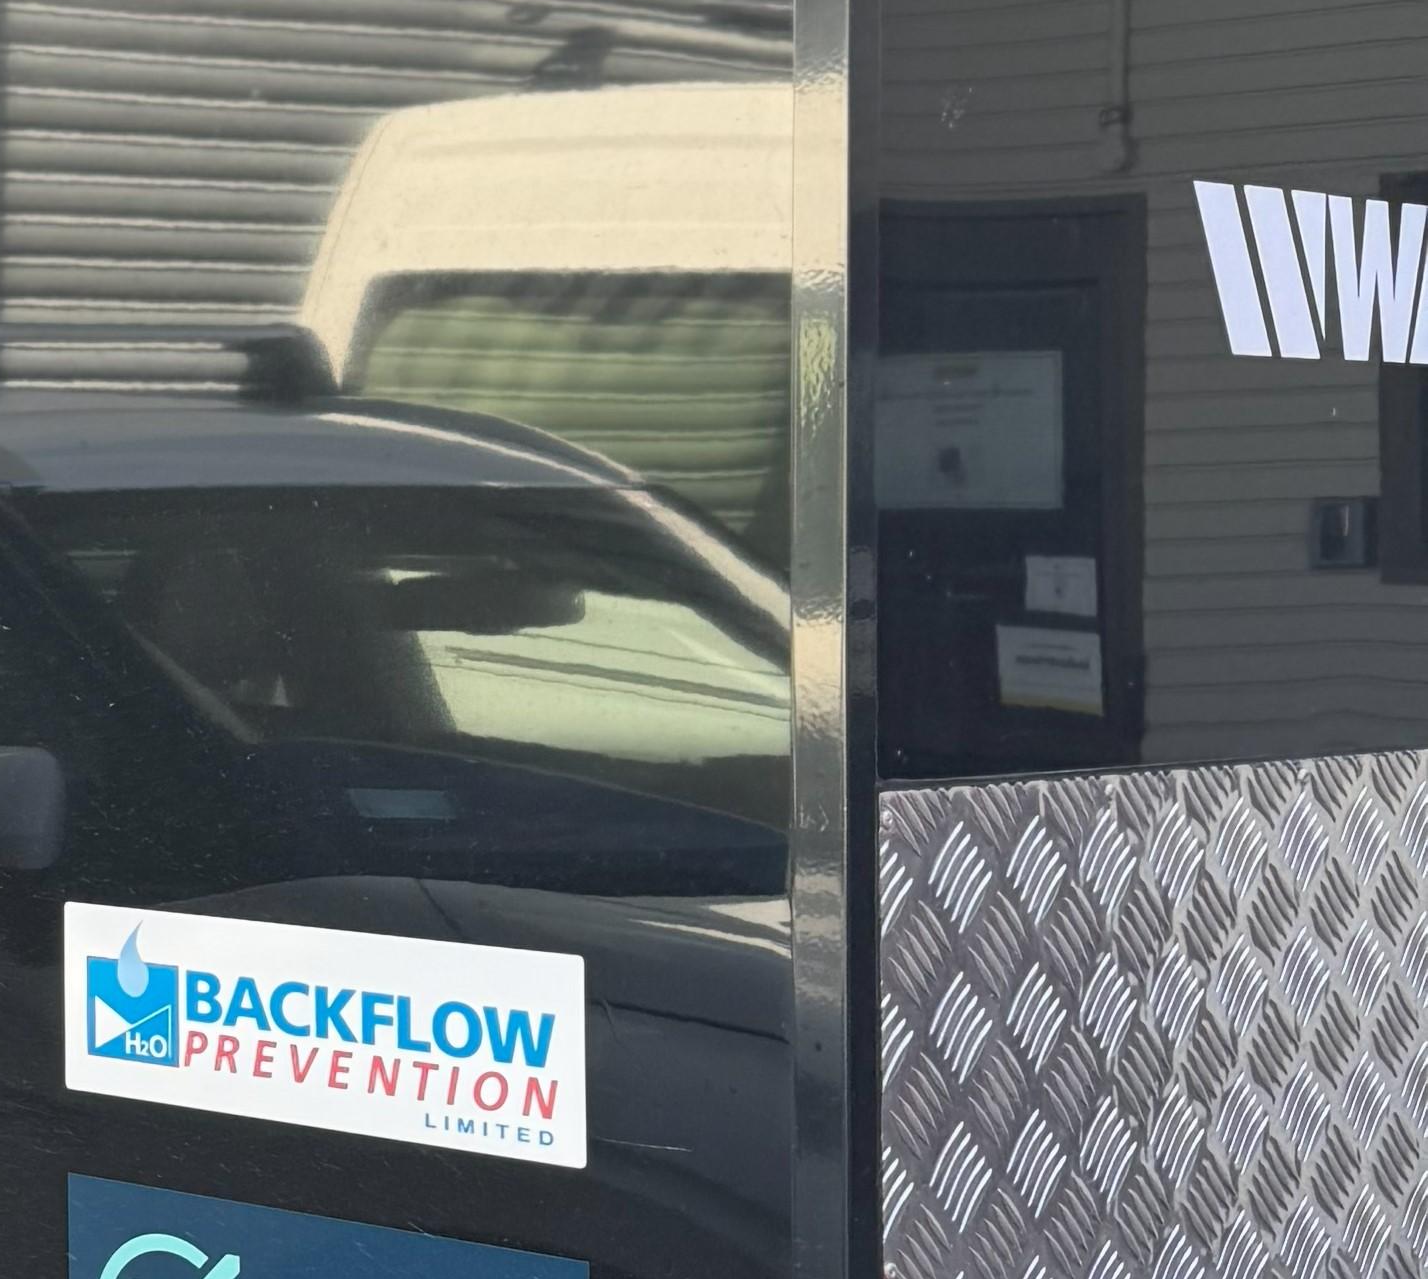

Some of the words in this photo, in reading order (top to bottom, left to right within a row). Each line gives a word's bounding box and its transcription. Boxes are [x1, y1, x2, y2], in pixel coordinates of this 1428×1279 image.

[185, 969, 556, 1069] BACKFLOW
[184, 1030, 559, 1120] PREVENTION
[424, 1112, 554, 1146] LIMITED
